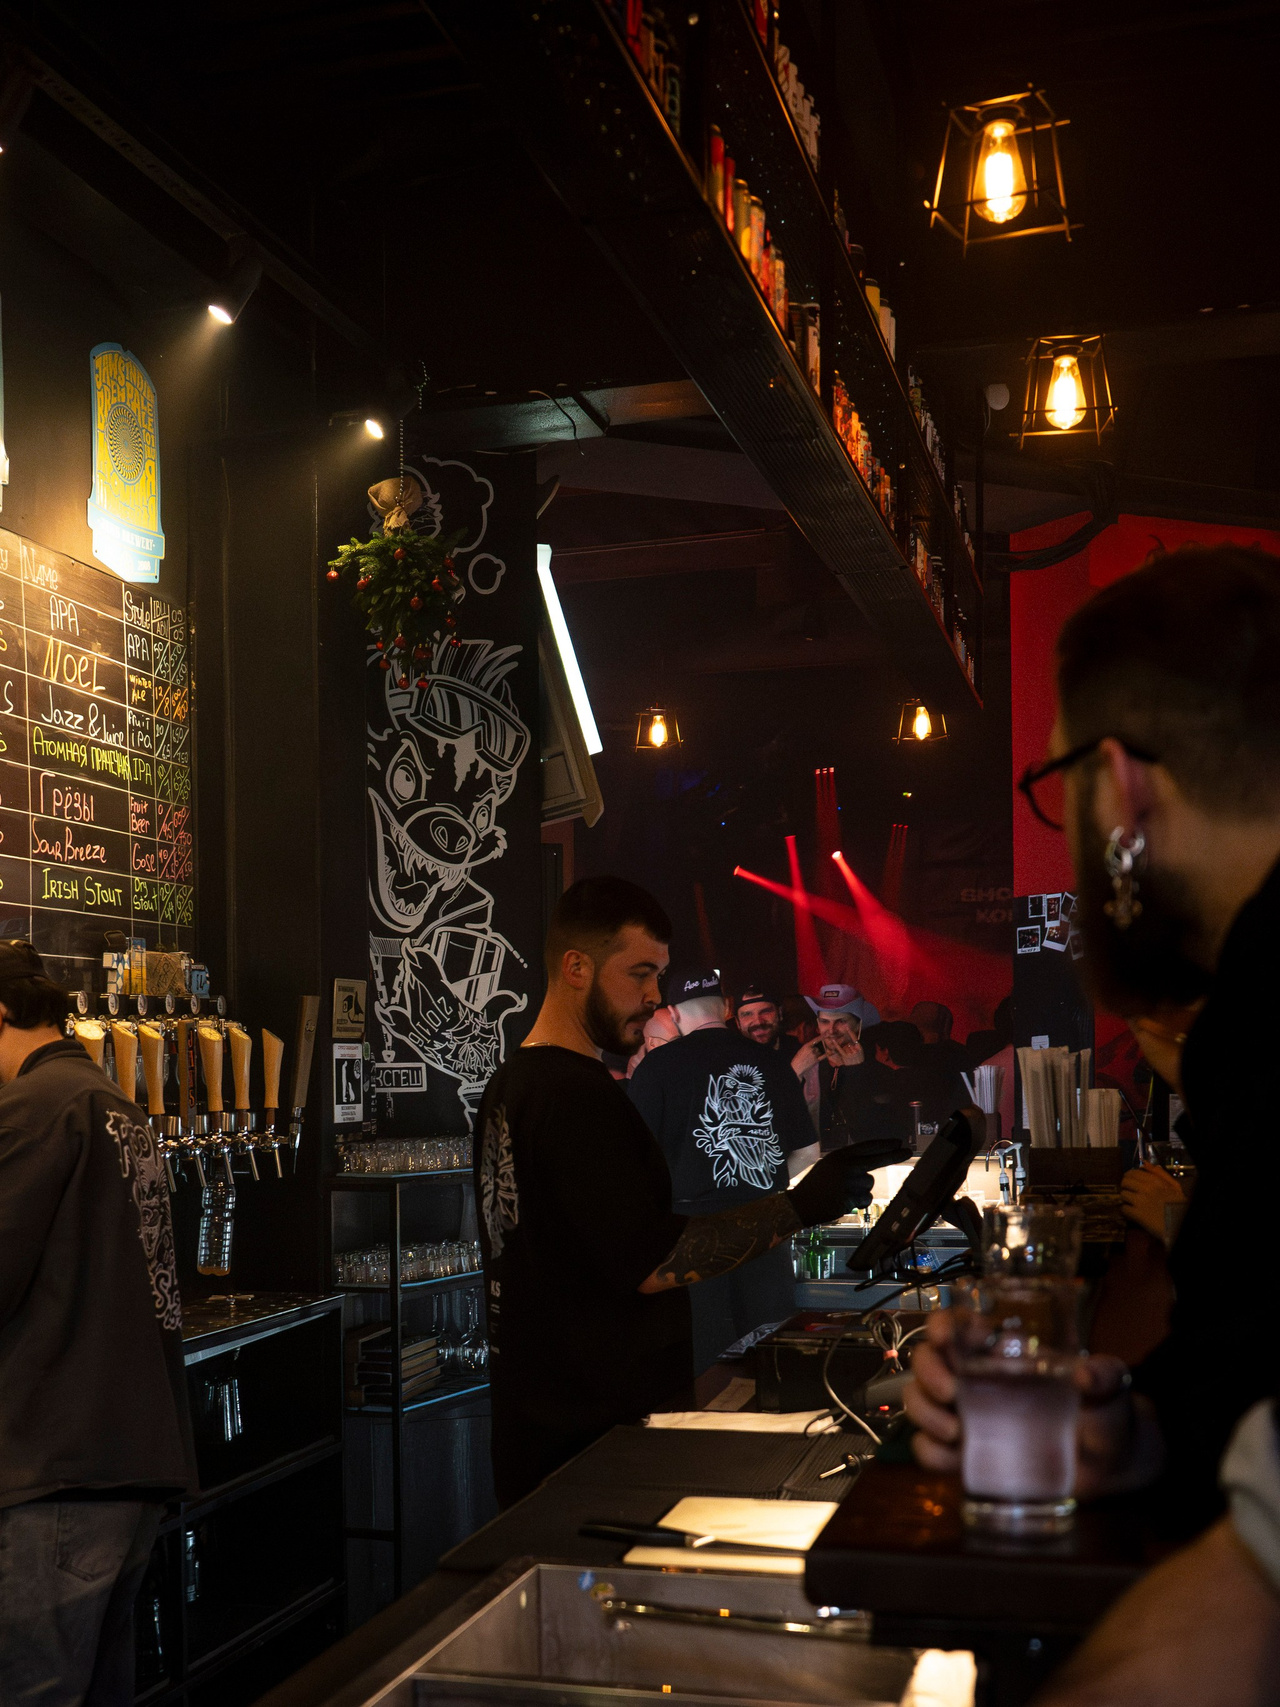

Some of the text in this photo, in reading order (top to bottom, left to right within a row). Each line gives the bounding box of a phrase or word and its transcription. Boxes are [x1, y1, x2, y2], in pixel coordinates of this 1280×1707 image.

[49, 595, 79, 636] APA
[128, 632, 150, 661] APA
[41, 684, 83, 731] Jazz
[132, 757, 153, 786] IPA
[131, 812, 151, 834] Beer
